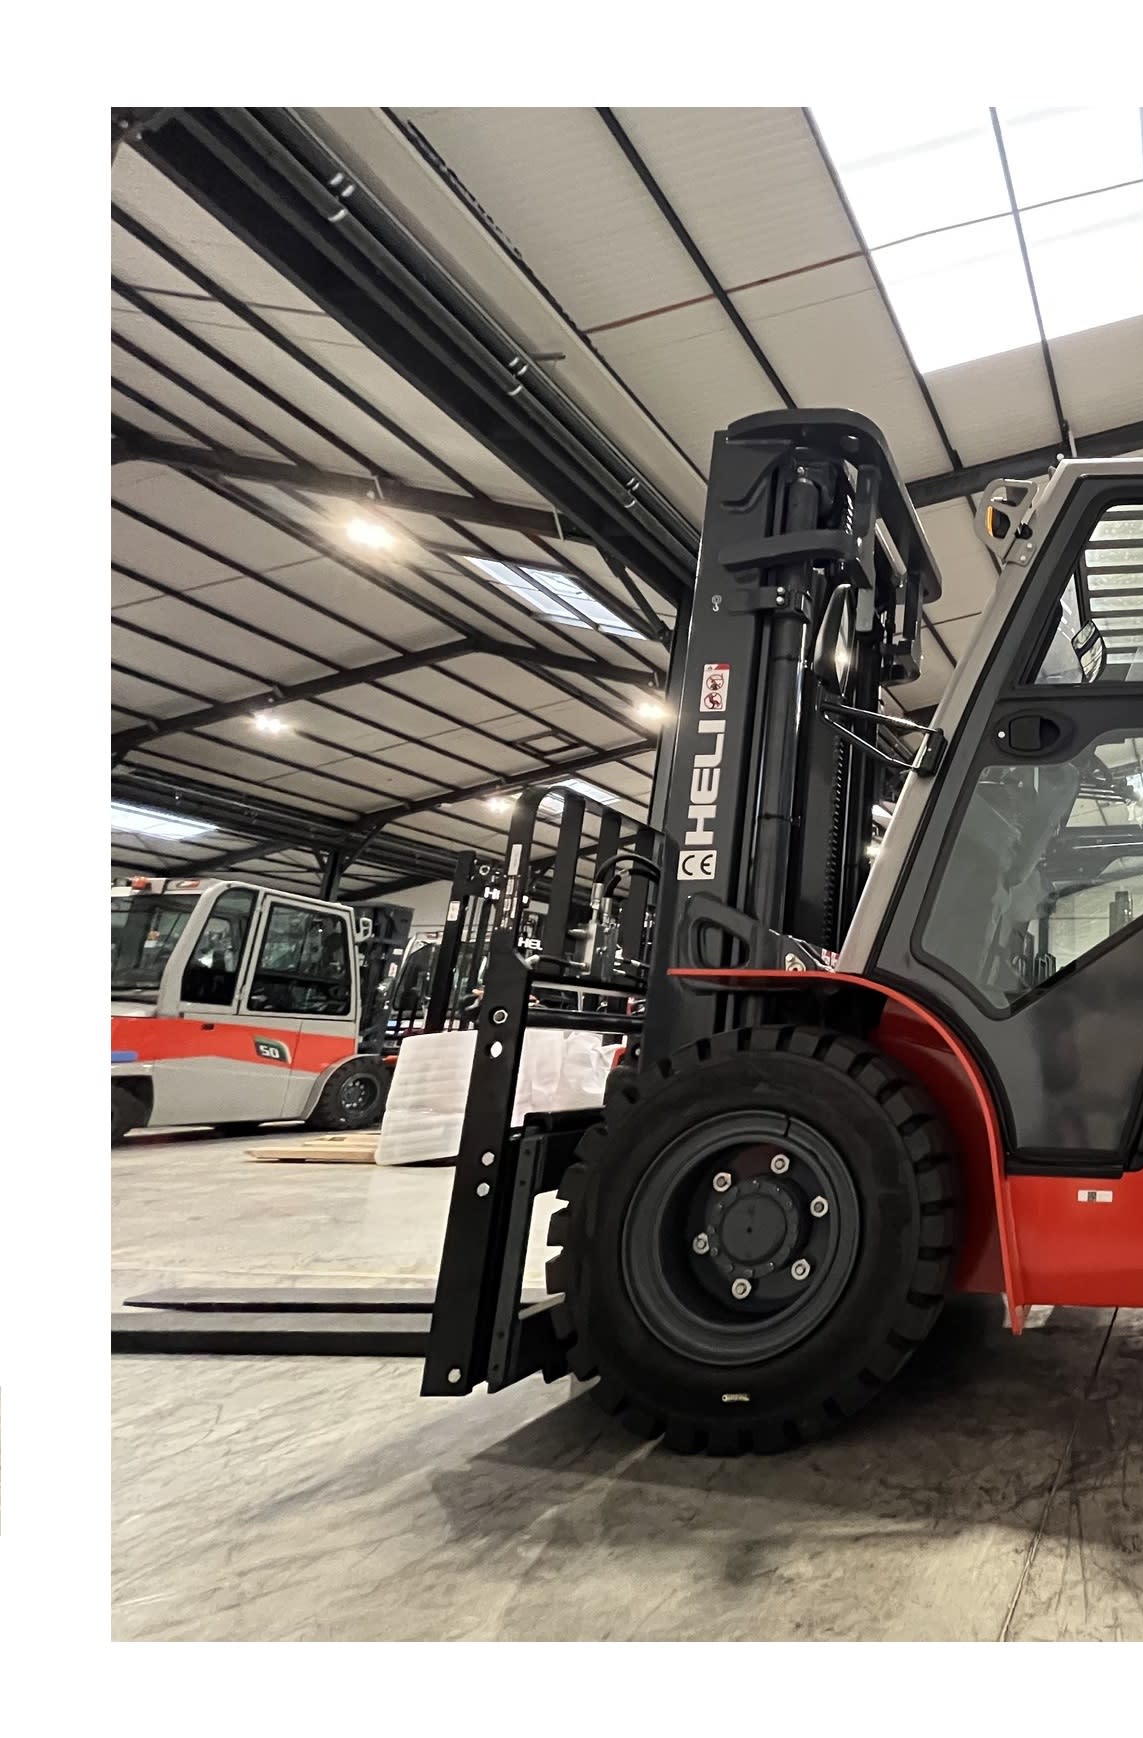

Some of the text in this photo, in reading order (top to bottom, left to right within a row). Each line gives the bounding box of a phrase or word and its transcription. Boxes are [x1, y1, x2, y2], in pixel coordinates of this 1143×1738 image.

[684, 719, 727, 846] HELI
[681, 854, 714, 876] CE
[517, 936, 544, 951] HEL
[259, 1045, 280, 1059] 50
